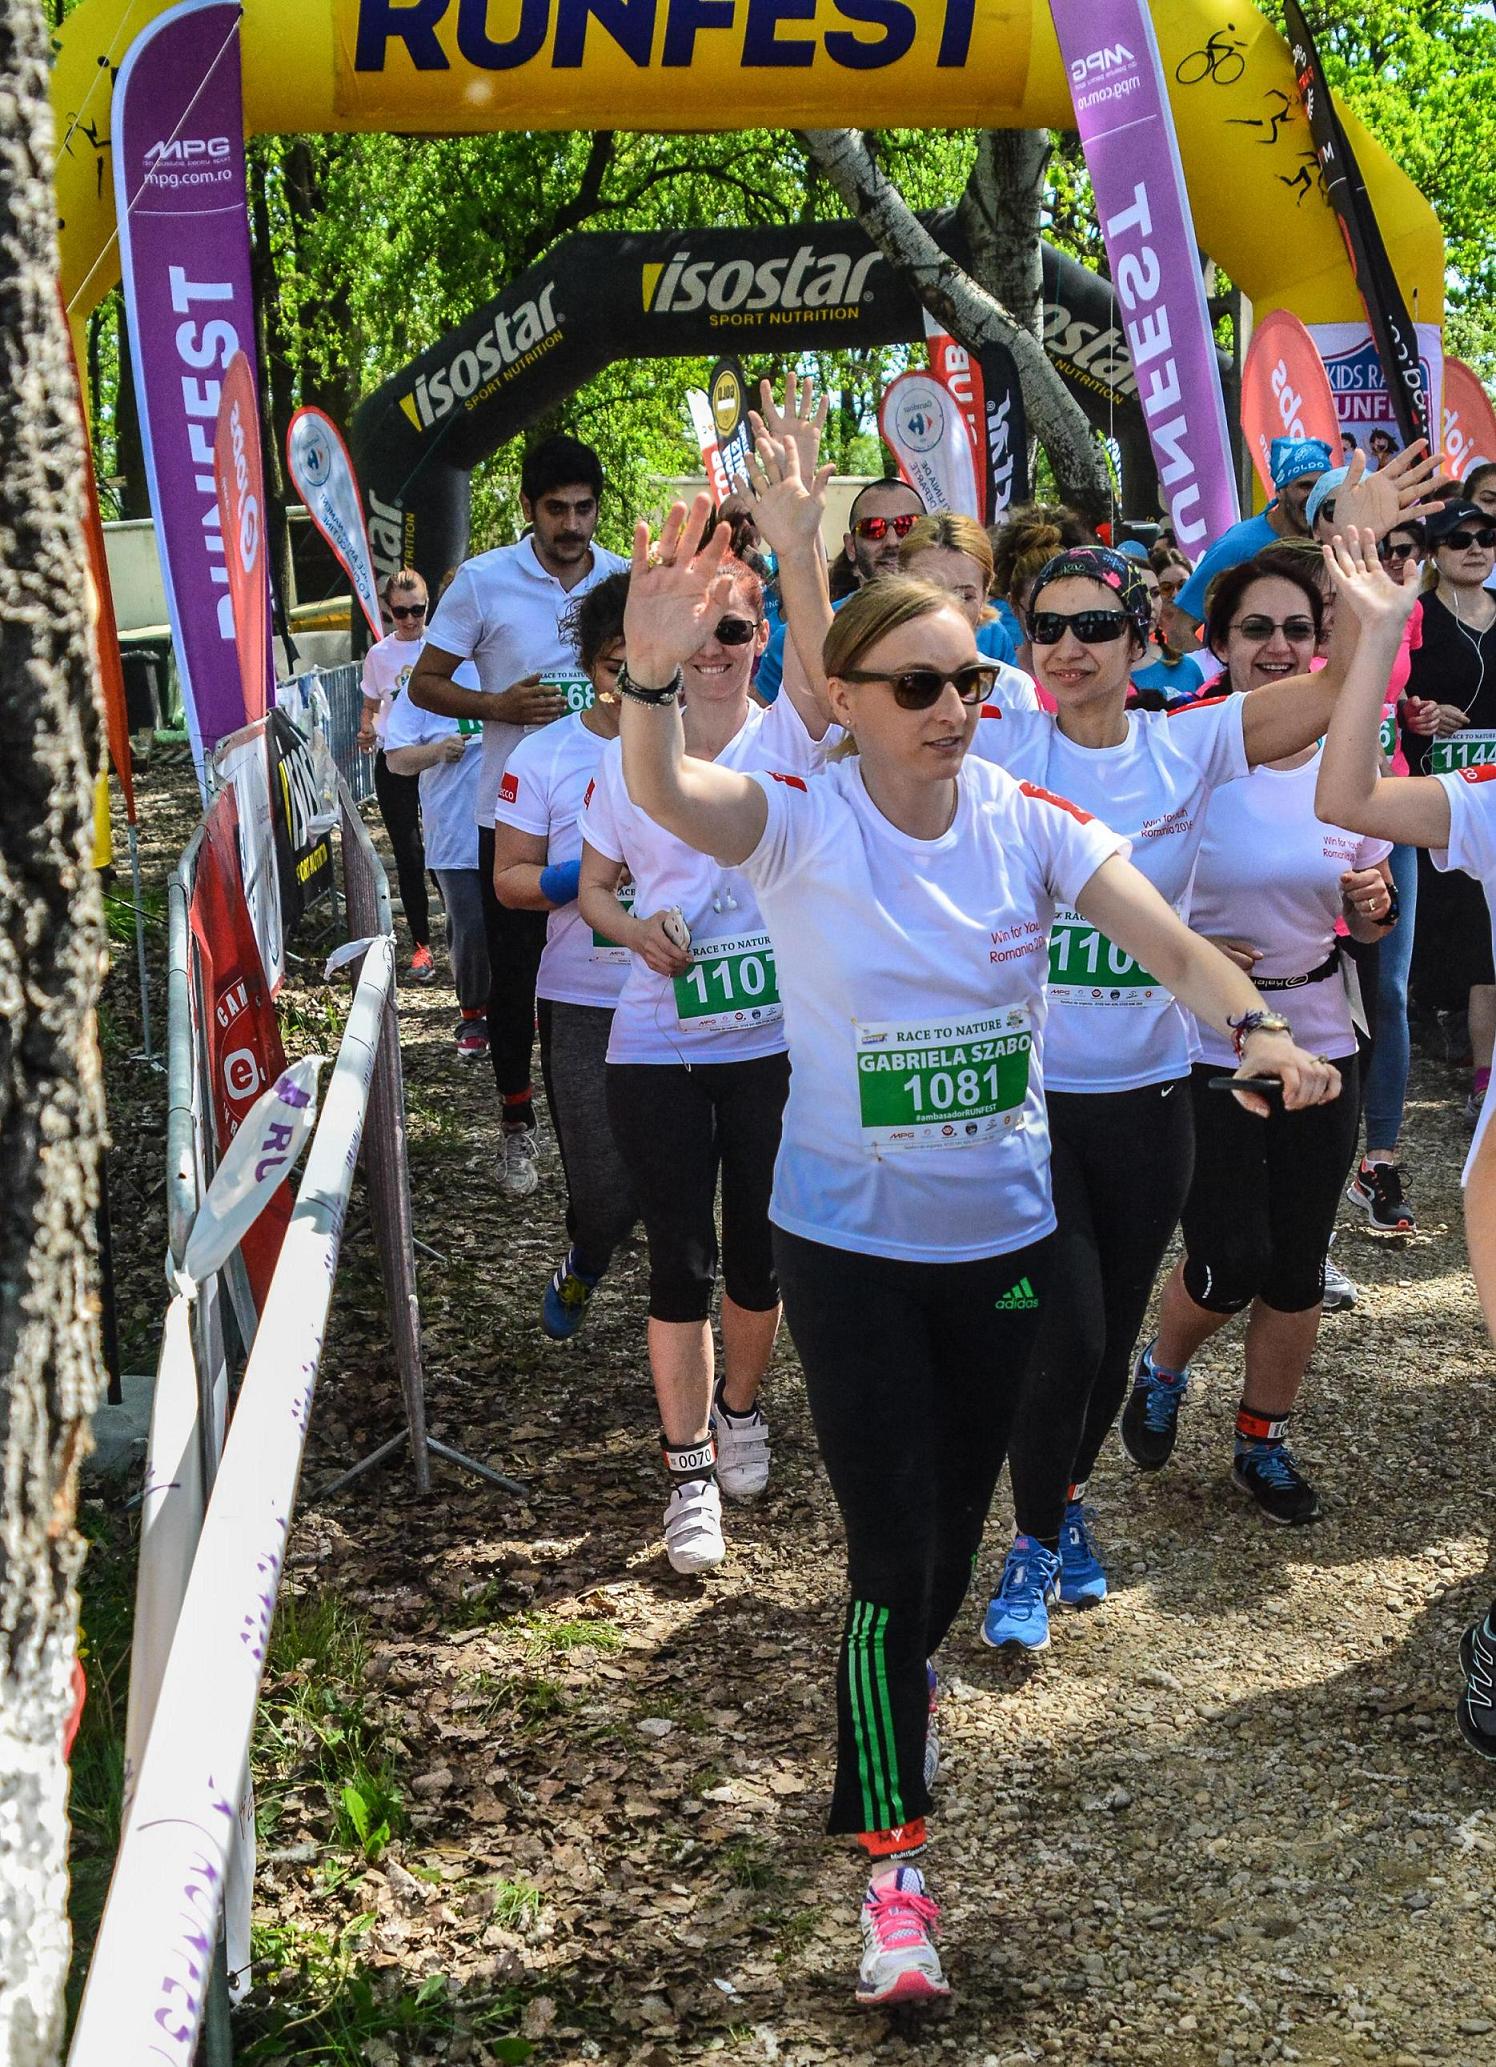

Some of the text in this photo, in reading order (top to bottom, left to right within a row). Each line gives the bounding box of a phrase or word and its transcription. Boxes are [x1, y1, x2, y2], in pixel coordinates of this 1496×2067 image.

[143, 136, 230, 159] MPG
[144, 169, 232, 188] mpg.com.ro
[655, 246, 884, 312] isostar
[709, 306, 859, 327] SPORT NUTRITION
[415, 281, 557, 430] isostar
[464, 331, 564, 412] SPORT NUTRITION
[1055, 358, 1124, 405] NUTRITION
[991, 930, 1010, 945] Win
[1011, 925, 1022, 939] for
[693, 945, 720, 957] RACE
[720, 941, 736, 952] TO
[990, 943, 1034, 963] Romania
[1050, 929, 1150, 975] 110
[896, 1030, 931, 1042] RACE
[934, 1027, 953, 1039] TO
[956, 1018, 1002, 1037] NATURE
[859, 1034, 1032, 1072] GABRIELA SZABO
[903, 1064, 999, 1112] 1081
[915, 1103, 998, 1122] #ambasadorRUNFEST
[995, 1297, 1039, 1309] adidas
[678, 1448, 712, 1469] 0070
